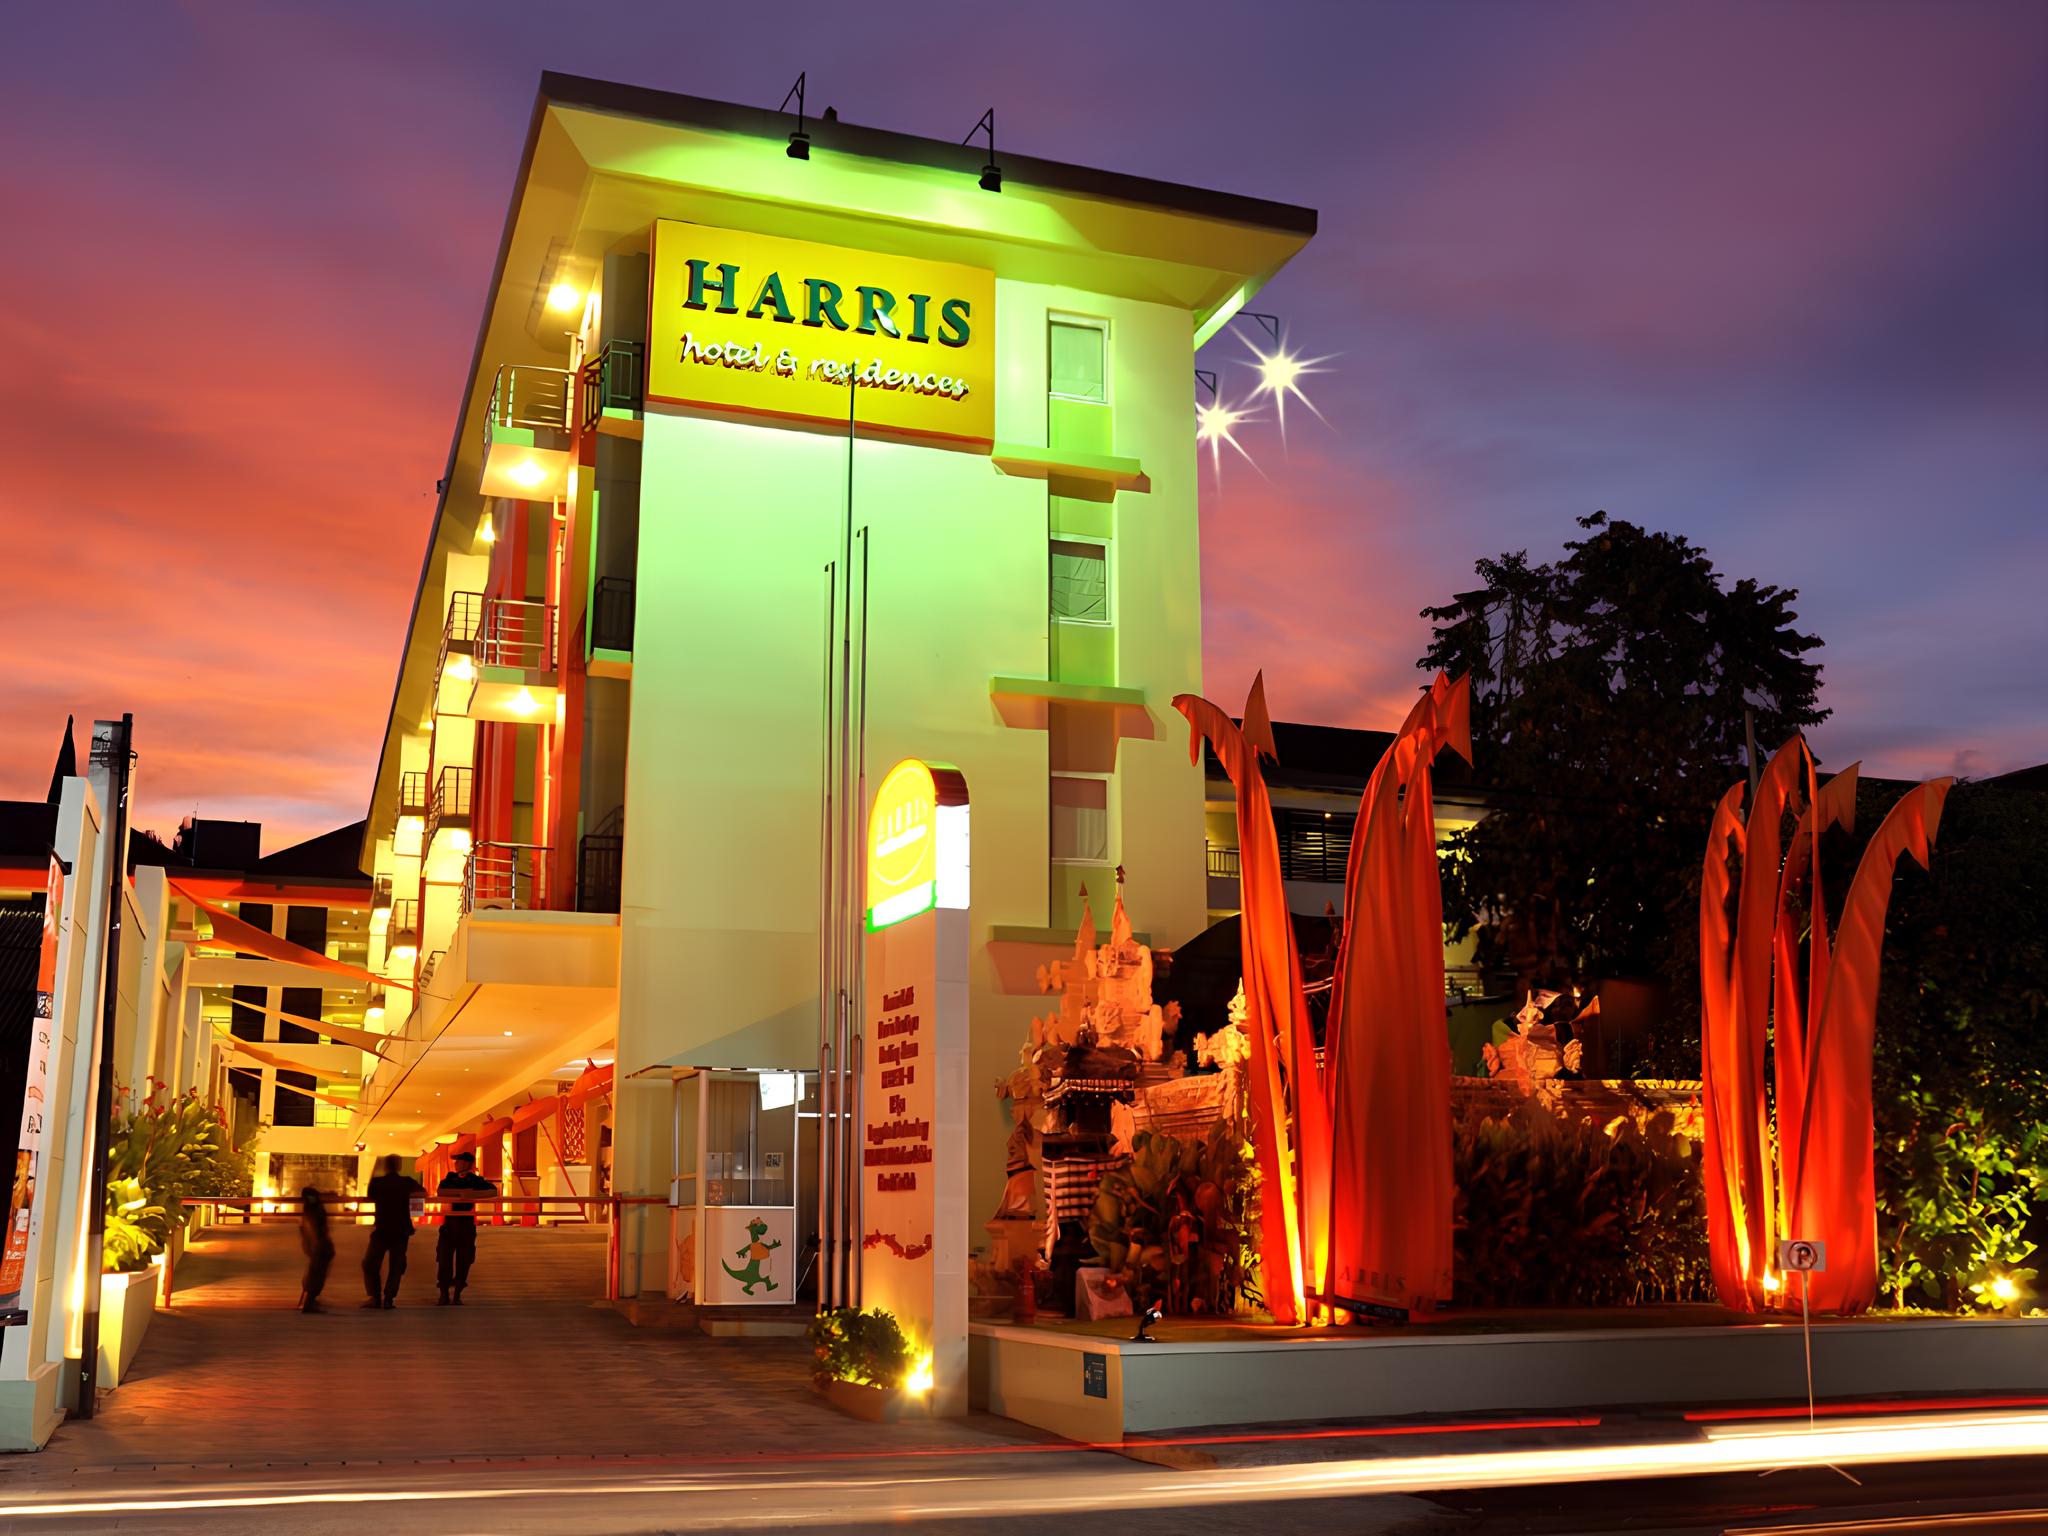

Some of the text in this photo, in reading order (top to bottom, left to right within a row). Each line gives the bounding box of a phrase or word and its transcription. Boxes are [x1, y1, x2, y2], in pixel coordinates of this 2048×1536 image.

[682, 258, 972, 348] HARRIS
[680, 331, 970, 402] hotel & residences
